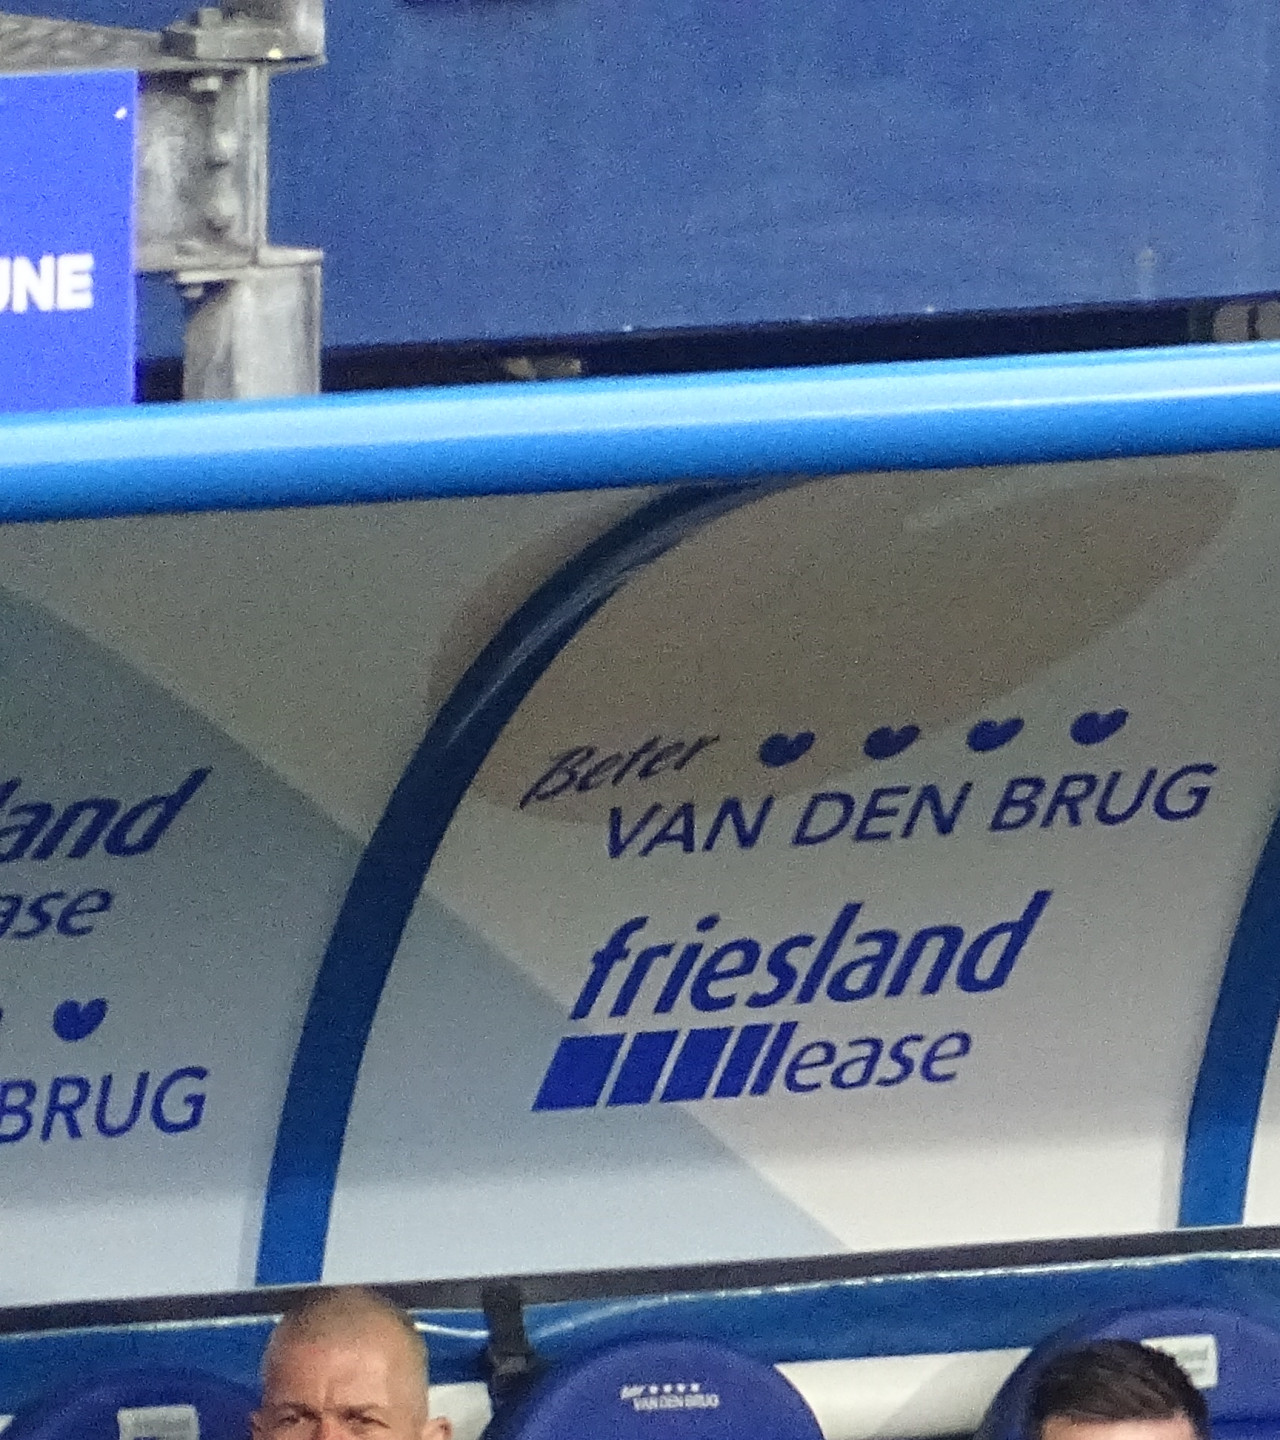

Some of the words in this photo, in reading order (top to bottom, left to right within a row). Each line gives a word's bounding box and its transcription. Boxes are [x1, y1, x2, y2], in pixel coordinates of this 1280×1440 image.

[519, 734, 721, 809] Beter
[605, 794, 775, 860] VAN
[790, 781, 973, 848] DEN
[988, 763, 1218, 833] BRUG
[569, 889, 1054, 1021] friesland
[749, 1020, 972, 1096] lease
